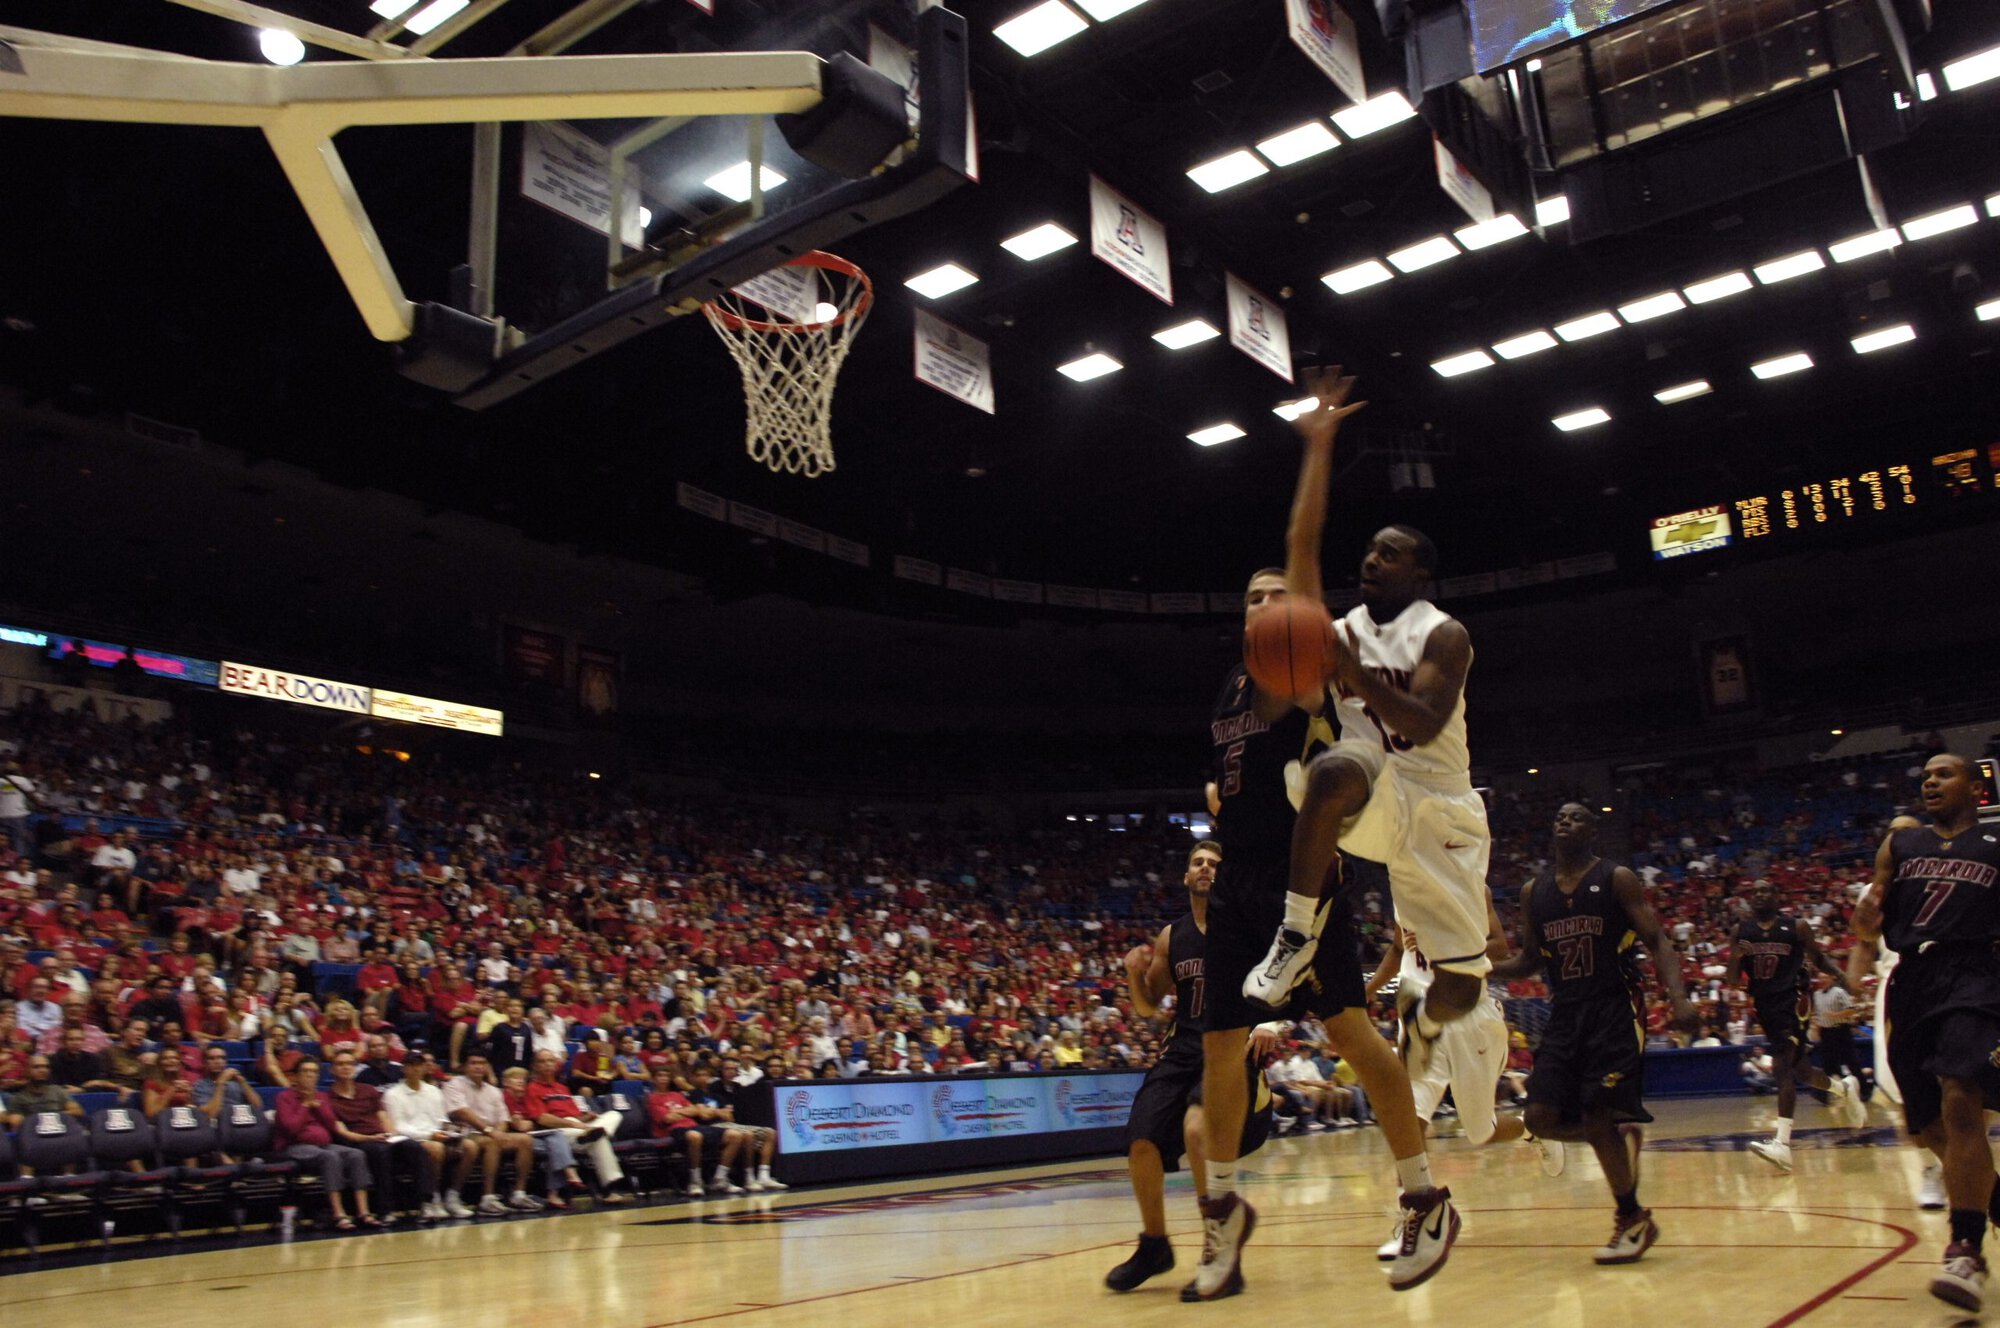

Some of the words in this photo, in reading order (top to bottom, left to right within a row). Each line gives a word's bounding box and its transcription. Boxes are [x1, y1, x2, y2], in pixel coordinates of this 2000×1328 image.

[1660, 537, 1727, 559] WATSON
[1222, 739, 1246, 796] 5
[1912, 880, 1957, 926] 7
[1557, 935, 1593, 980] 21
[796, 1104, 851, 1122] DESERT
[852, 1102, 914, 1119] DIAMOND
